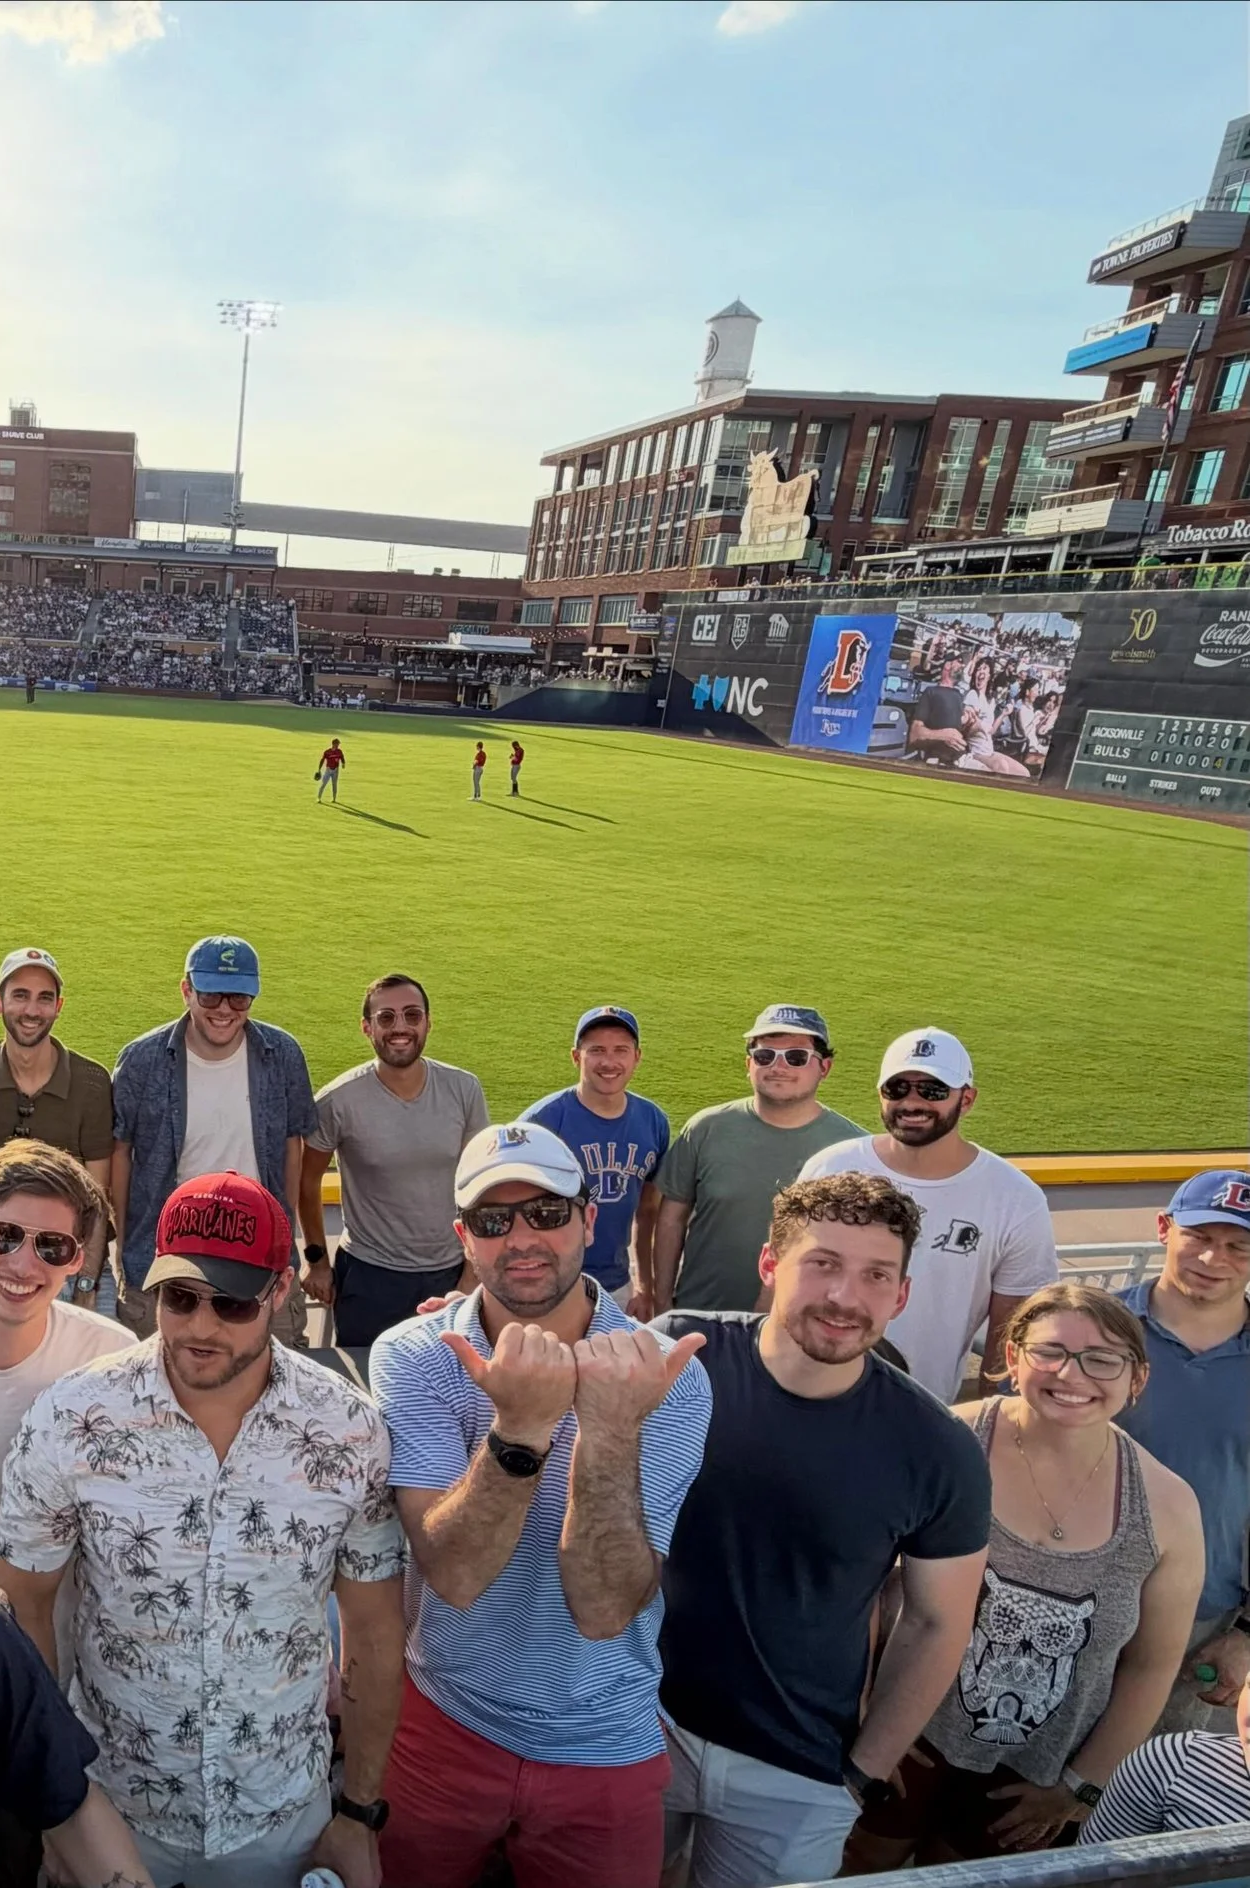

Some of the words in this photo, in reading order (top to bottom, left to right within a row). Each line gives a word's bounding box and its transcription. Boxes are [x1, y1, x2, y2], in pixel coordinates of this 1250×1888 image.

[1102, 249, 1129, 272] TOWNE
[1129, 229, 1175, 260] PROPERTIES
[2, 430, 25, 439] SHAVE
[26, 432, 45, 440] CLUB
[1167, 524, 1229, 543] Tobacco
[692, 614, 722, 641] CEI
[1120, 608, 1157, 646] 50
[1220, 610, 1250, 622] RAN
[726, 676, 769, 717] NC
[1091, 726, 1145, 741] JACKSONVILLE
[1156, 732, 1164, 742] 7
[1168, 733, 1177, 744] 0
[1183, 734, 1188, 745] 1
[1194, 735, 1202, 746] 0
[1207, 736, 1216, 747] 2
[1221, 738, 1230, 749] 0
[1161, 719, 1167, 730] 1
[1171, 720, 1180, 731] 2
[1185, 721, 1193, 732] 3
[1197, 722, 1206, 733] 4
[1211, 723, 1219, 734] 5
[1224, 724, 1233, 735] 6
[1238, 725, 1247, 736] 7
[1093, 744, 1131, 759] BULLS
[1150, 751, 1159, 762] 0
[1164, 752, 1170, 762] 1
[1175, 753, 1183, 765] 0
[1188, 754, 1196, 766] 0
[1201, 756, 1210, 768] 0
[1214, 758, 1225, 769] 4
[1105, 773, 1127, 783] BALLS
[1200, 786, 1222, 796] OUTS
[580, 1141, 657, 1181] ULLS
[193, 1192, 234, 1204] CAROLINA
[166, 1202, 256, 1247] HURRICANES
